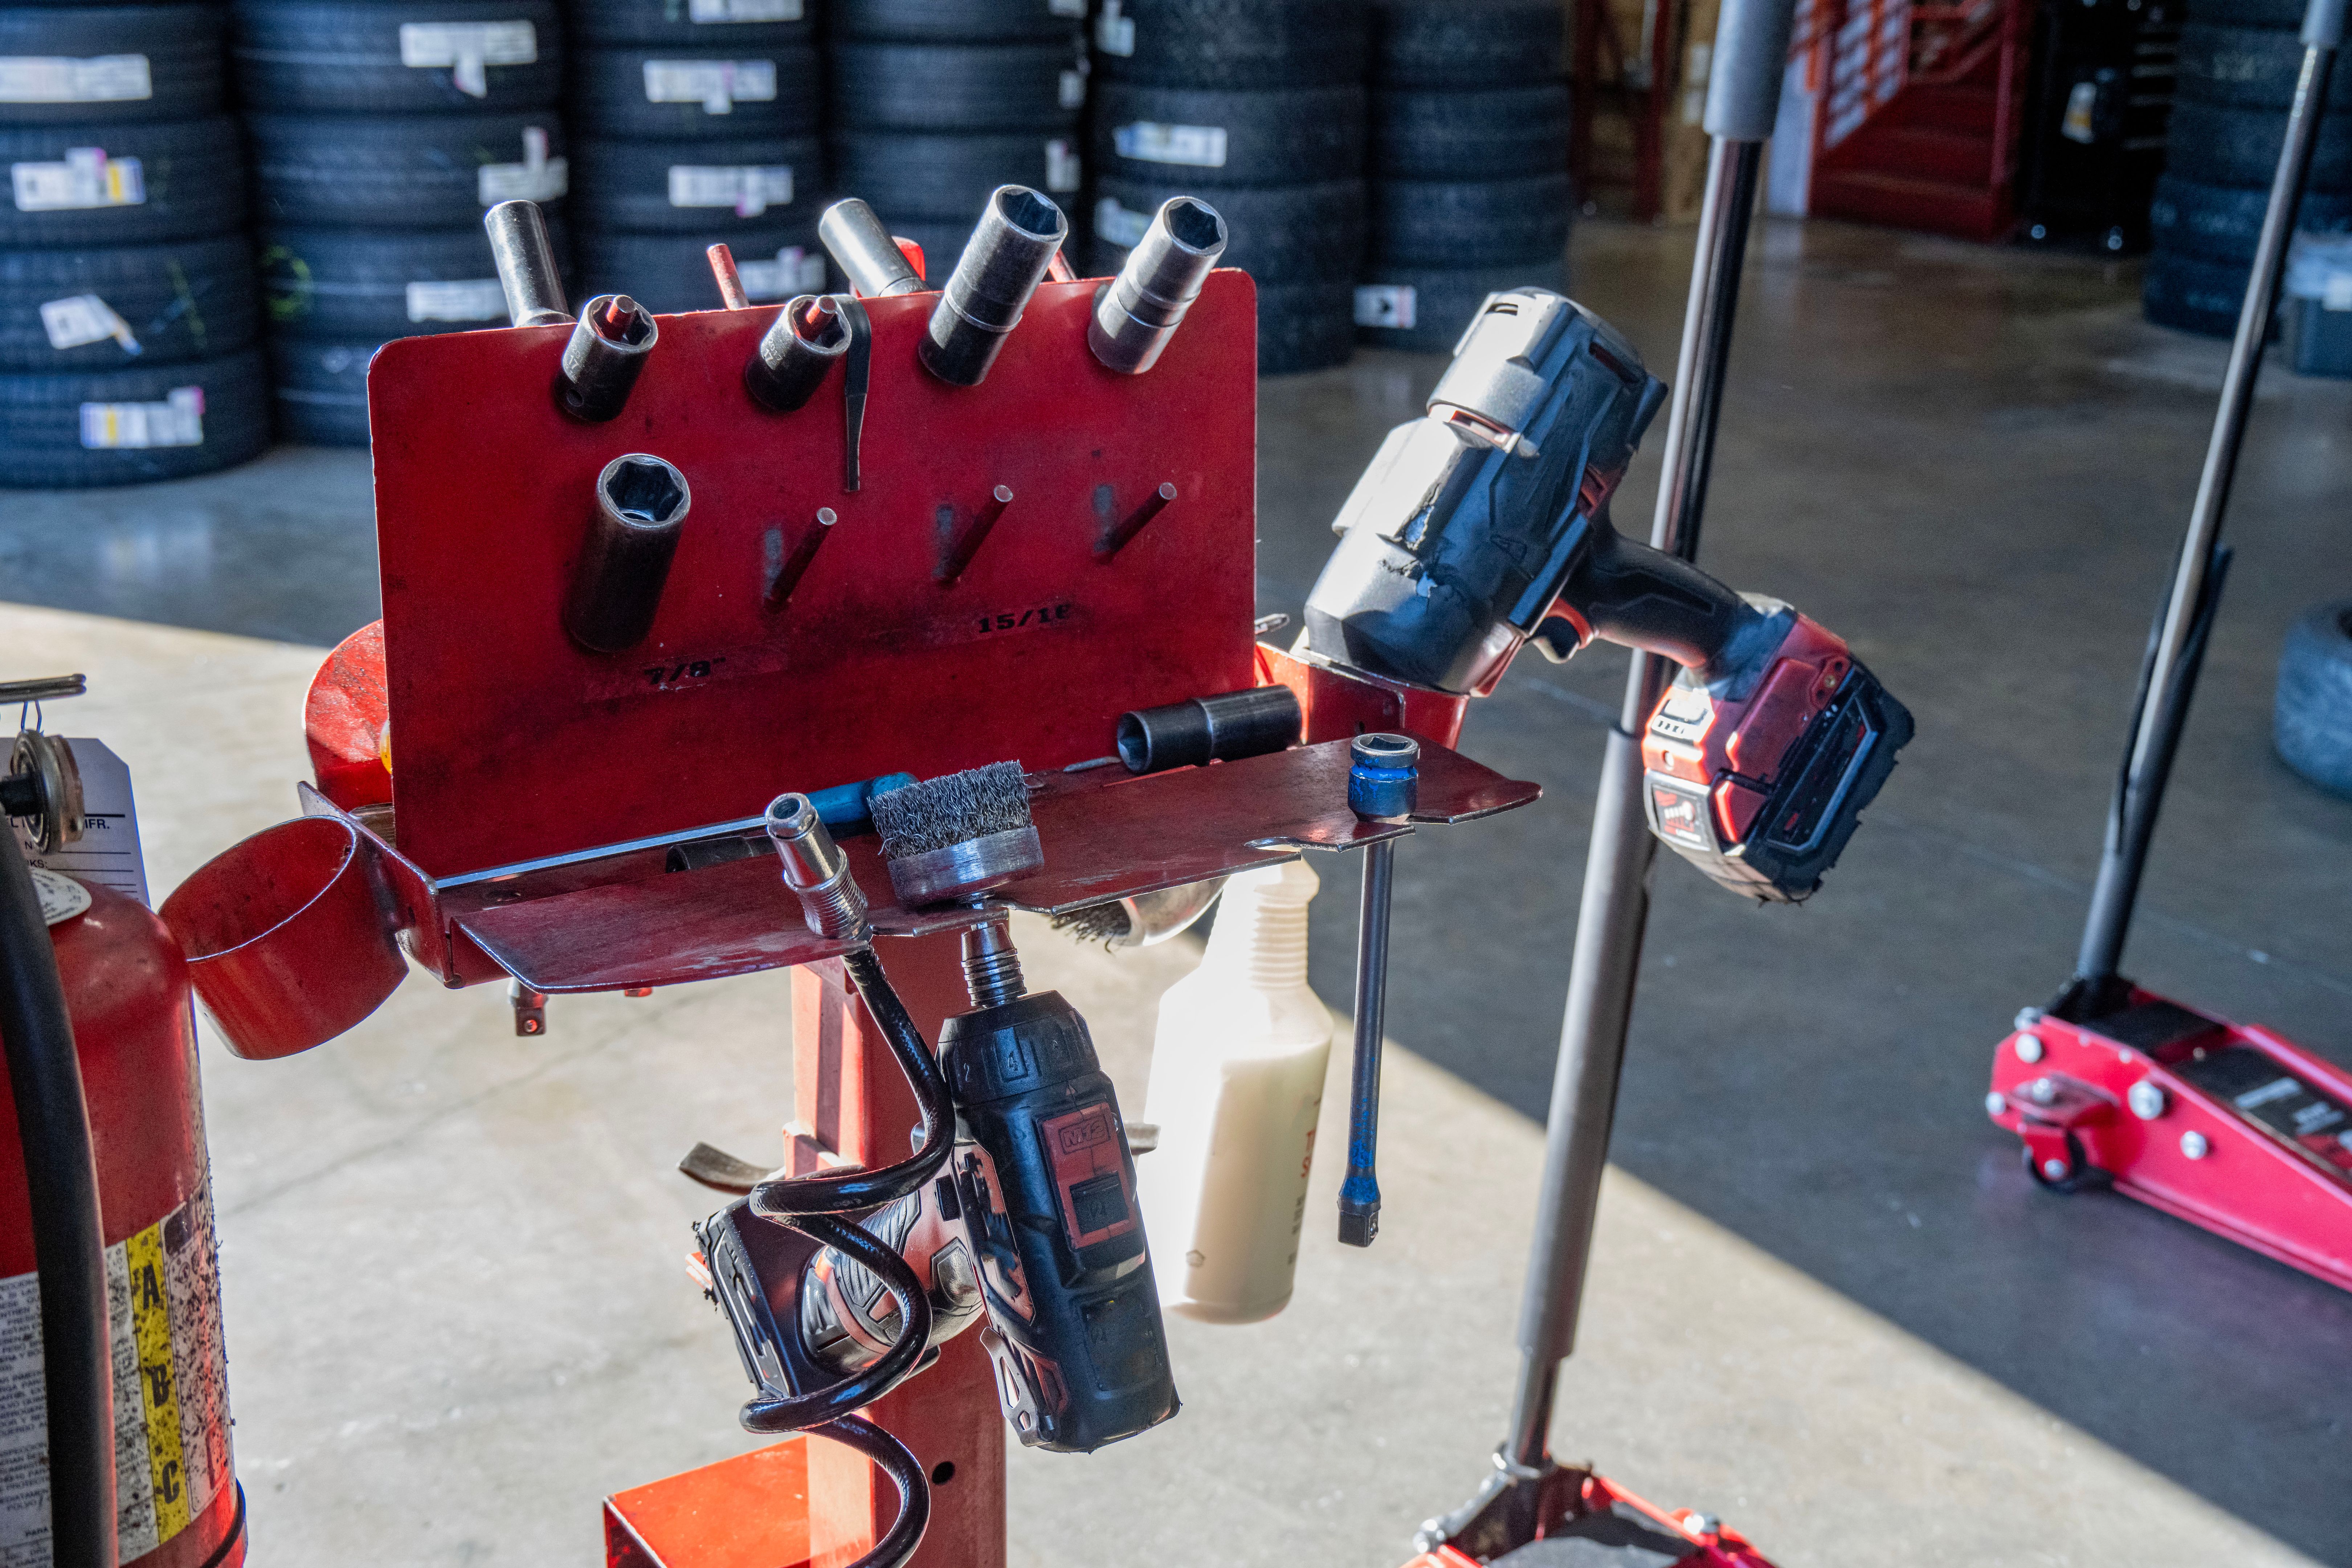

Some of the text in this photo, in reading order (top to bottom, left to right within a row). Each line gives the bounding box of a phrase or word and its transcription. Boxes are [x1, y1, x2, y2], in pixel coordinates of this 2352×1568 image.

[1063, 1119, 1108, 1148] M12
[143, 1263, 180, 1504] A B C
